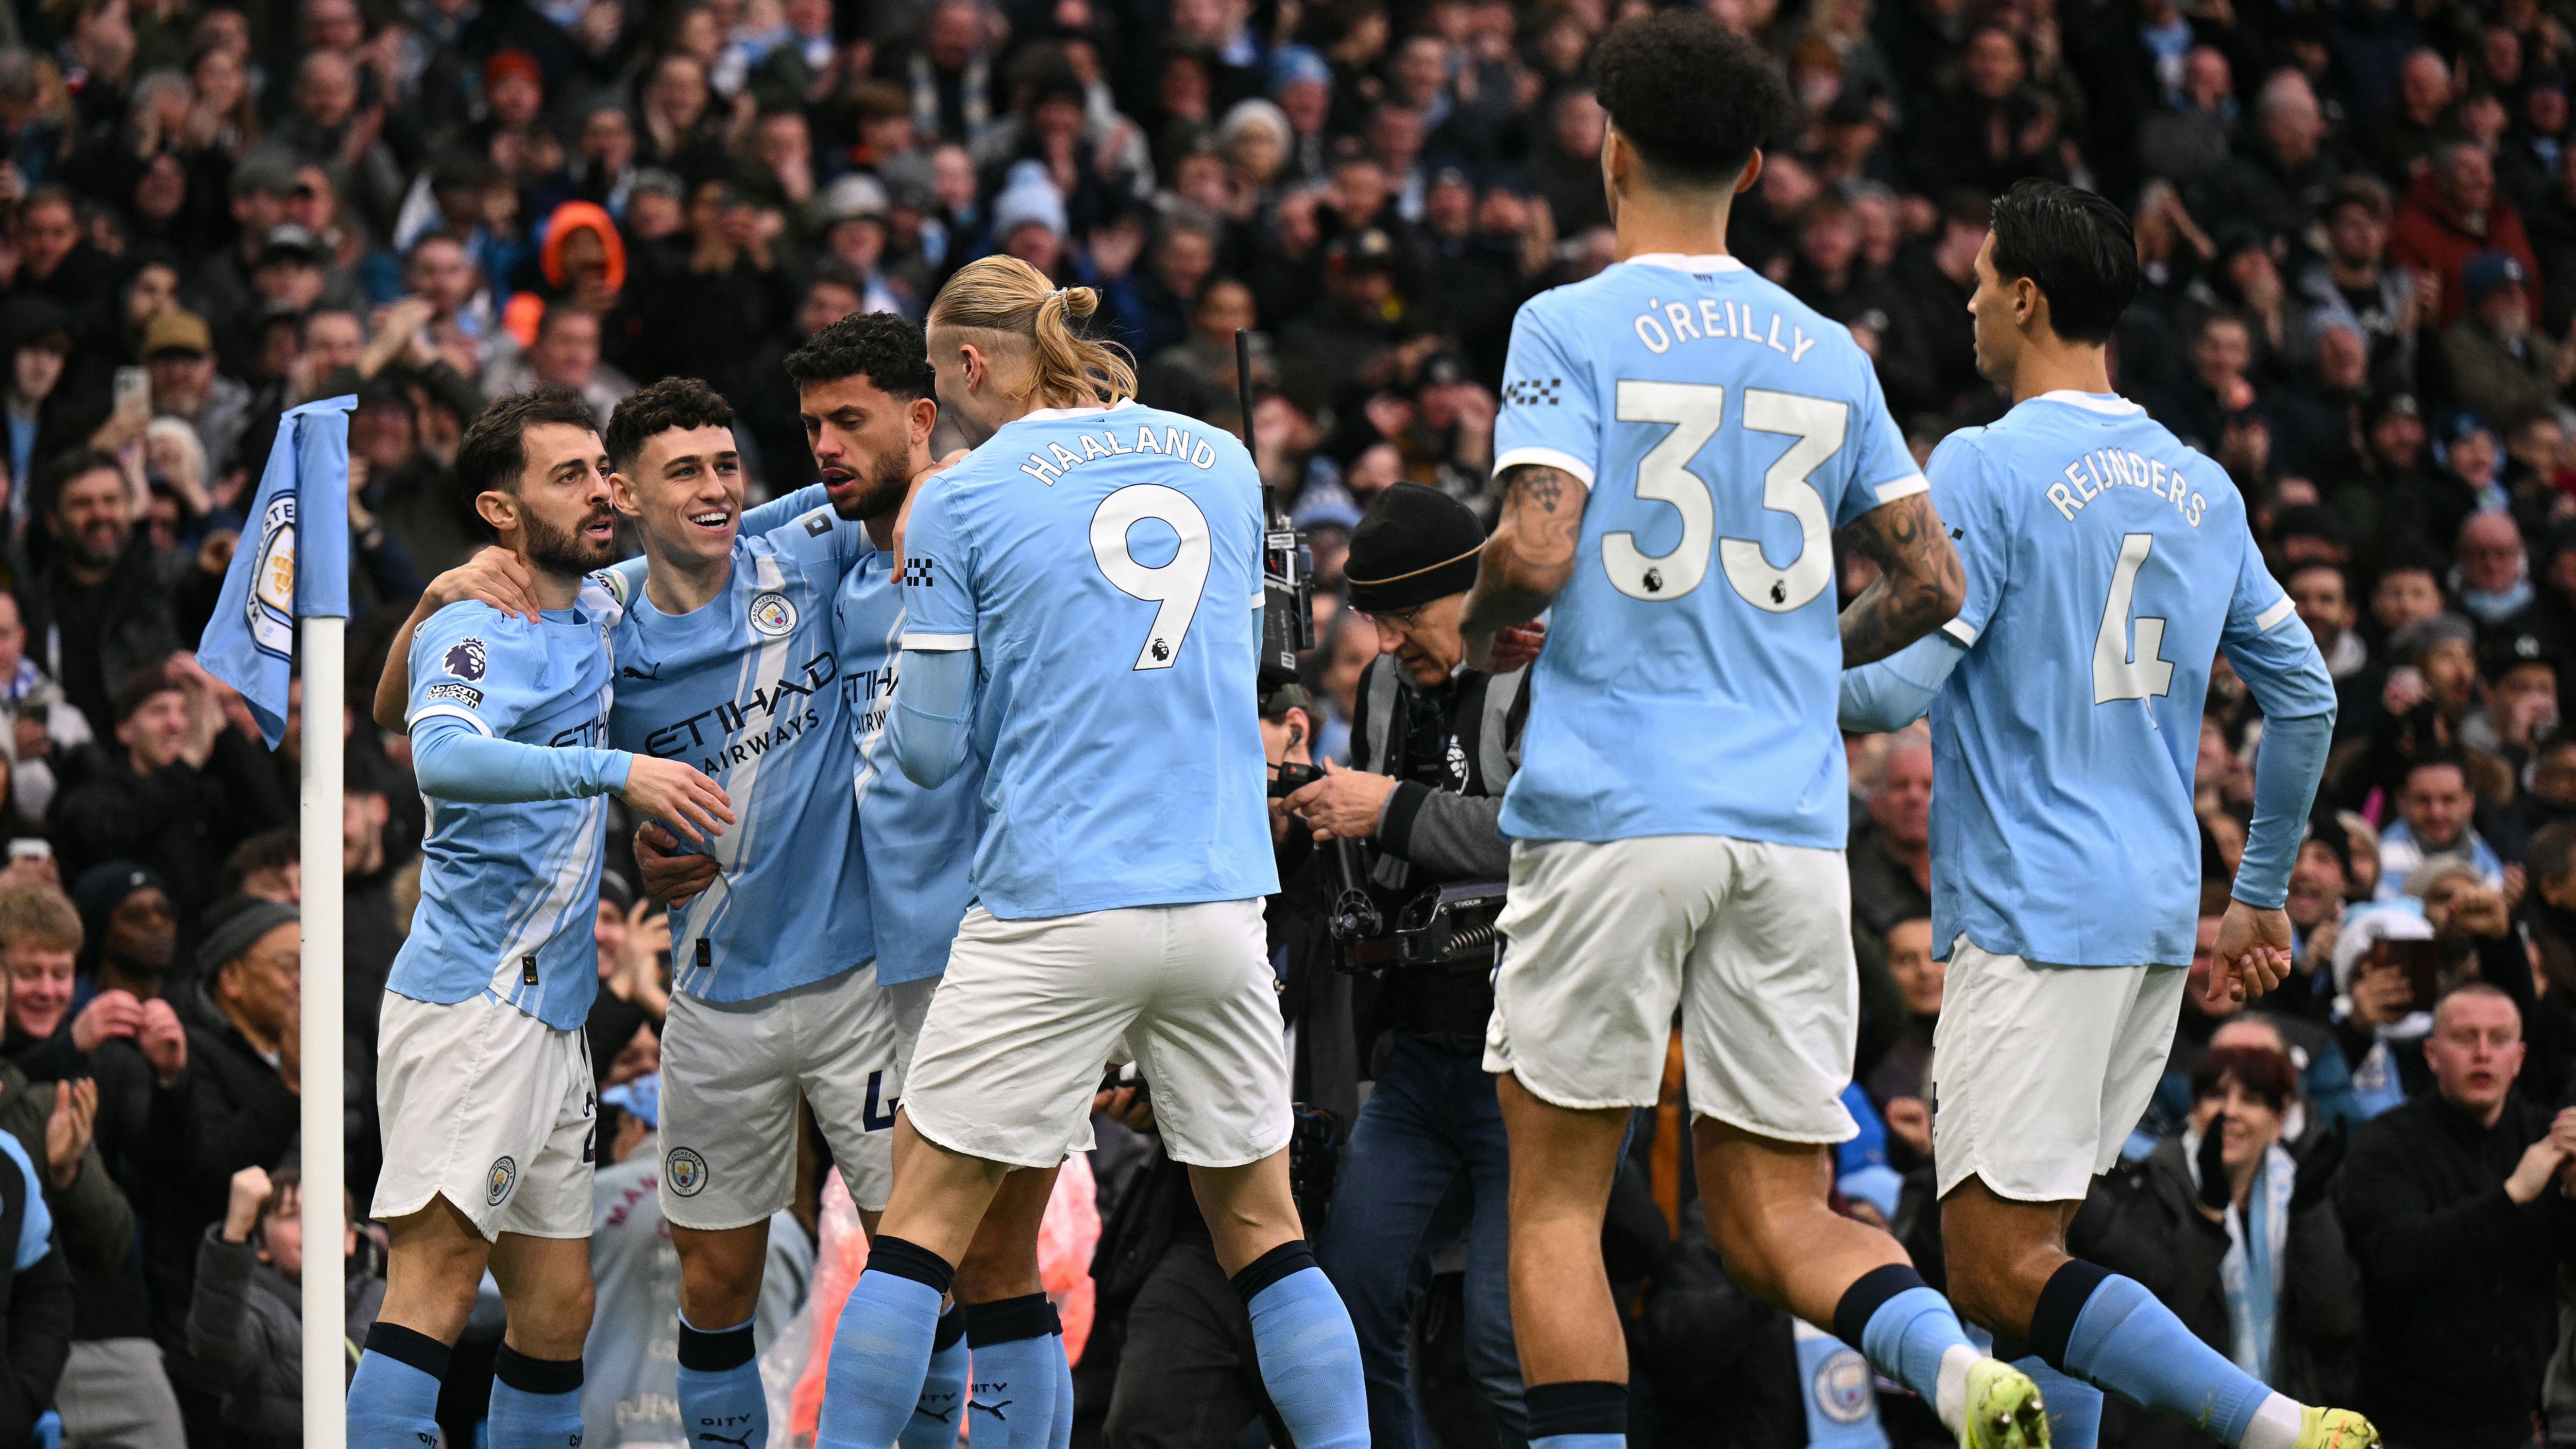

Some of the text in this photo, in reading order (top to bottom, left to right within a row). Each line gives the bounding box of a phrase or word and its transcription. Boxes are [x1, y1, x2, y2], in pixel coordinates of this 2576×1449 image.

[1020, 426, 1216, 487] HAALAND
[1601, 379, 1850, 612] 33
[2045, 447, 2207, 528] REIJNDERS
[1089, 483, 1212, 671] 9
[753, 595, 782, 622] MANCHESTER
[2092, 533, 2175, 706] 4
[782, 622, 793, 633] CITY
[426, 691, 479, 710] for racism
[430, 684, 478, 700] No room
[645, 652, 837, 758] ETIHAD
[855, 710, 886, 735] AIRW
[704, 709, 820, 773] AIRWAYS
[493, 1159, 513, 1180] MANCHESTER
[669, 1151, 702, 1166] MANCHESTER
[971, 1383, 1007, 1392] ITY
